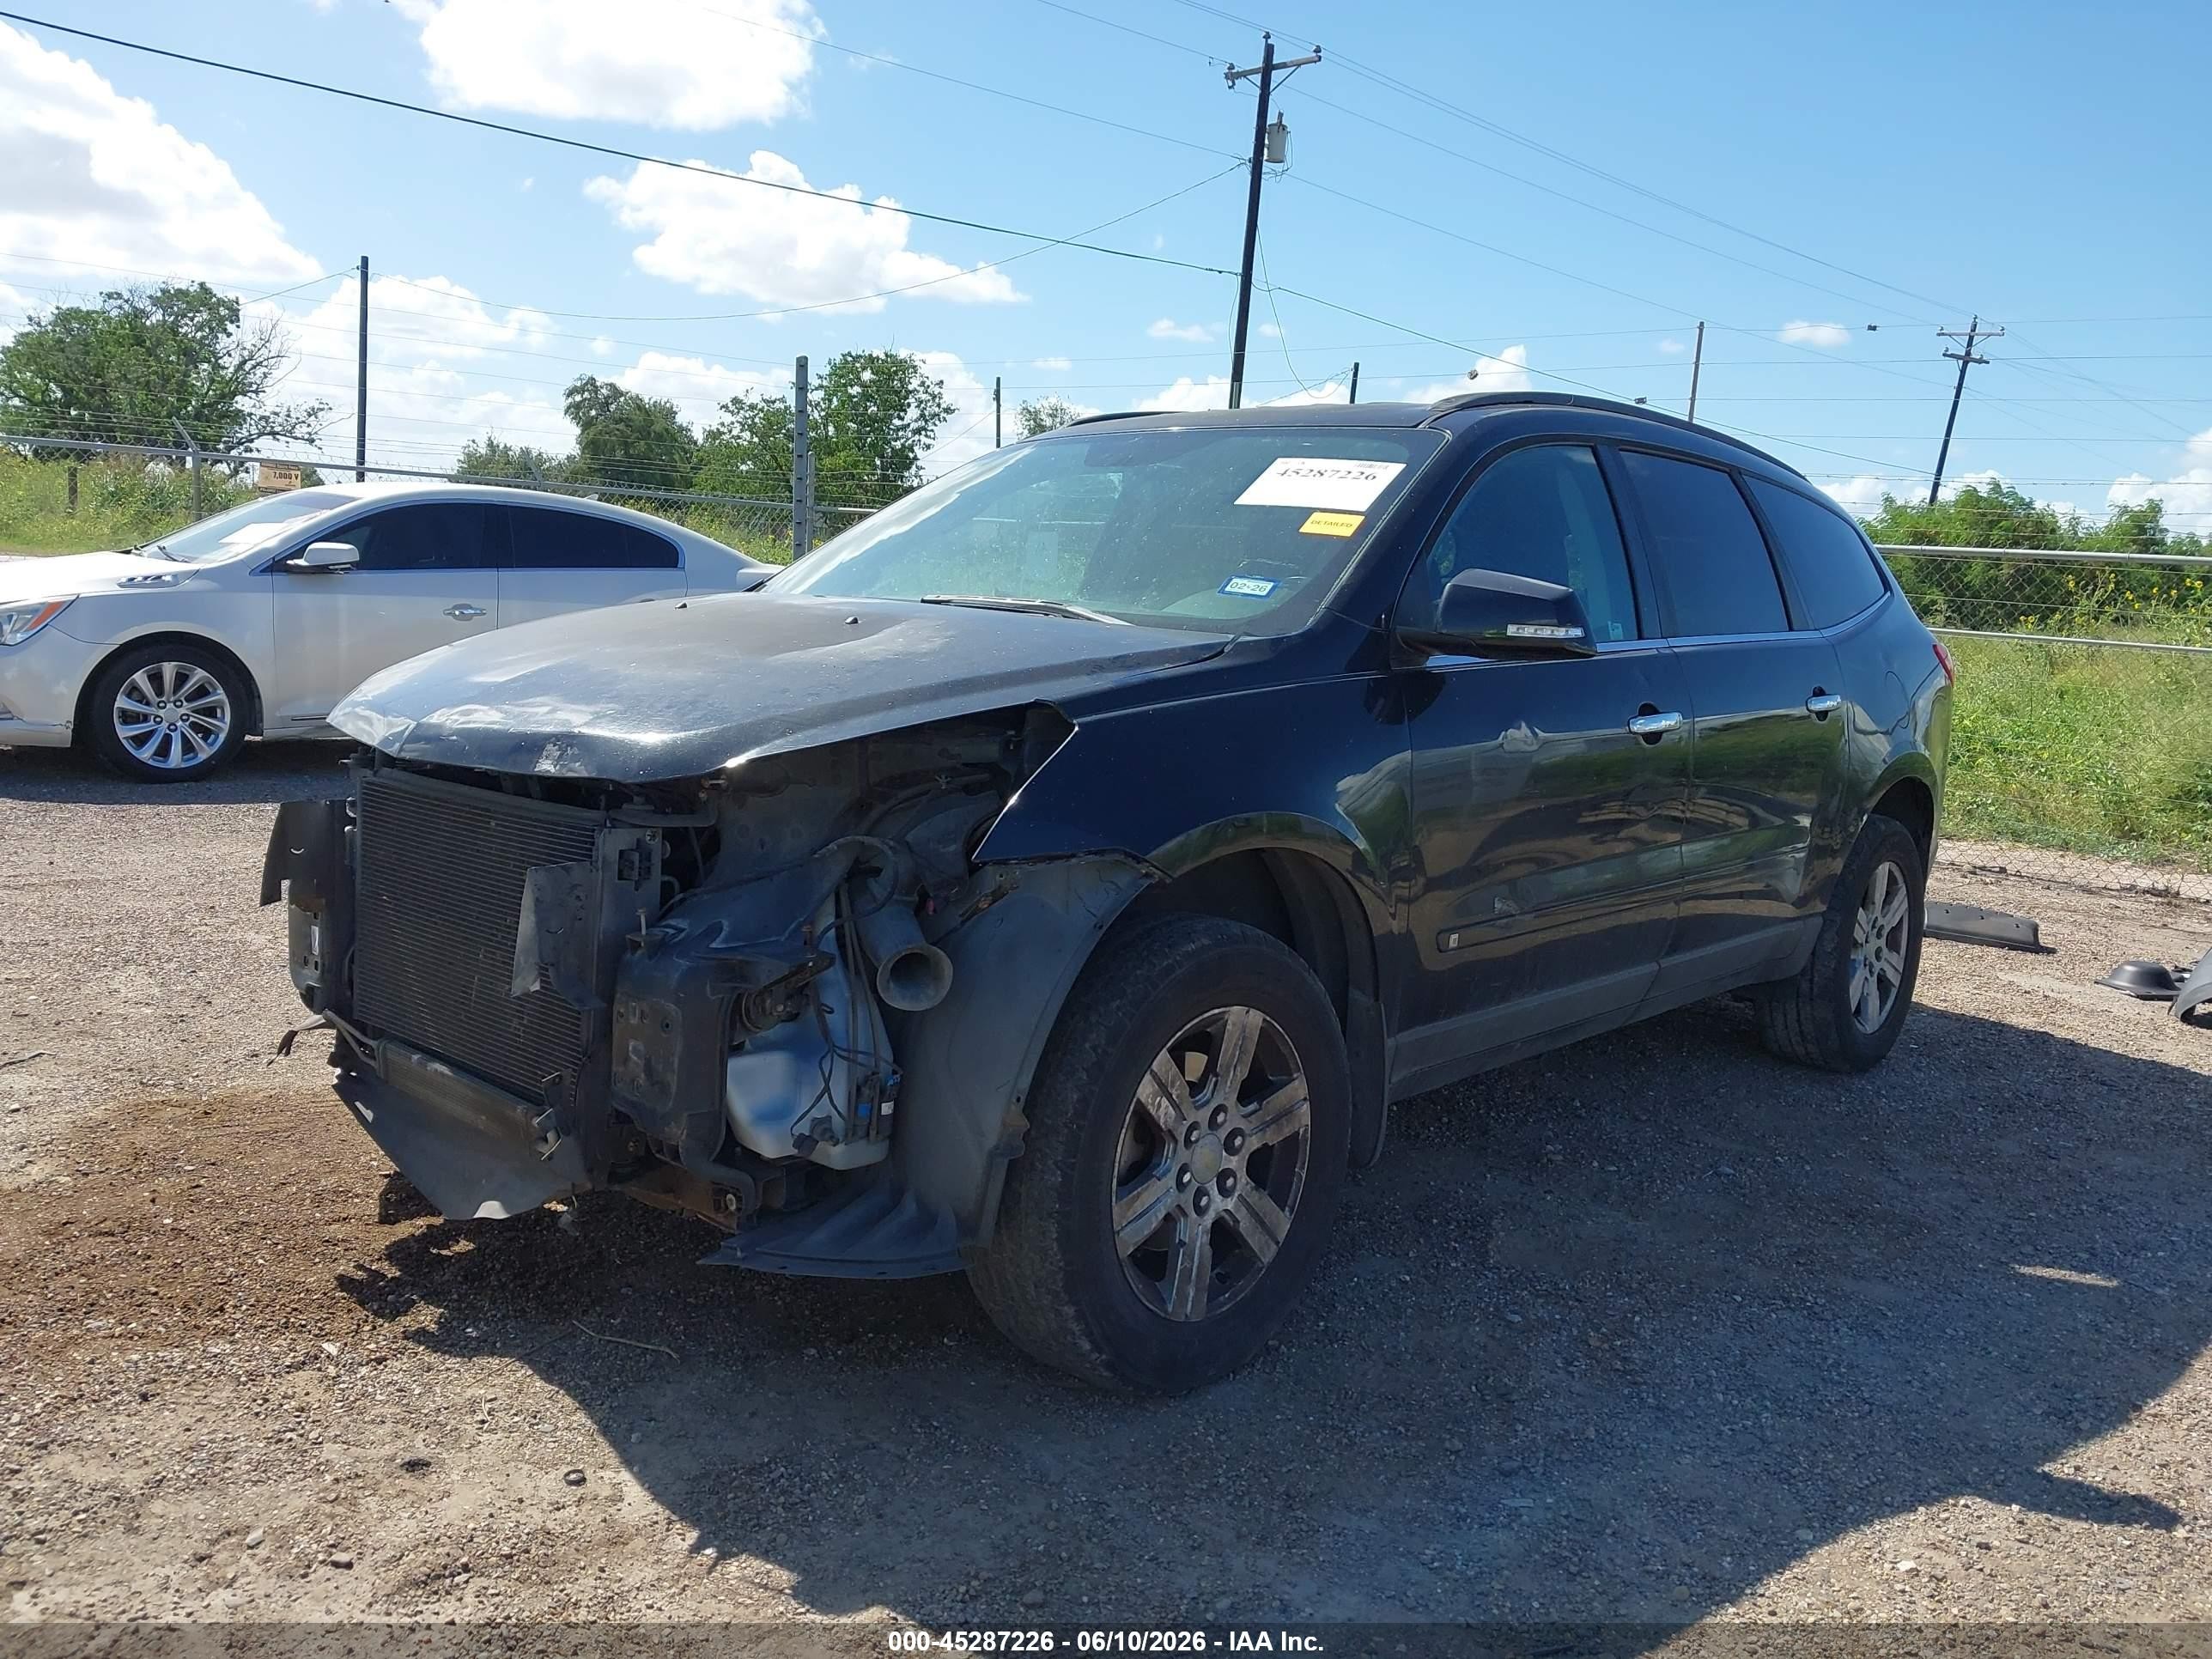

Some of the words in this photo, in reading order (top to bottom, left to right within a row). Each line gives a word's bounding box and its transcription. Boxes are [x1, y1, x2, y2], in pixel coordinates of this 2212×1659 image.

[273, 471, 293, 480] 7,000
[1277, 468, 1377, 481] 45287226
[1310, 520, 1353, 528] DETAILED
